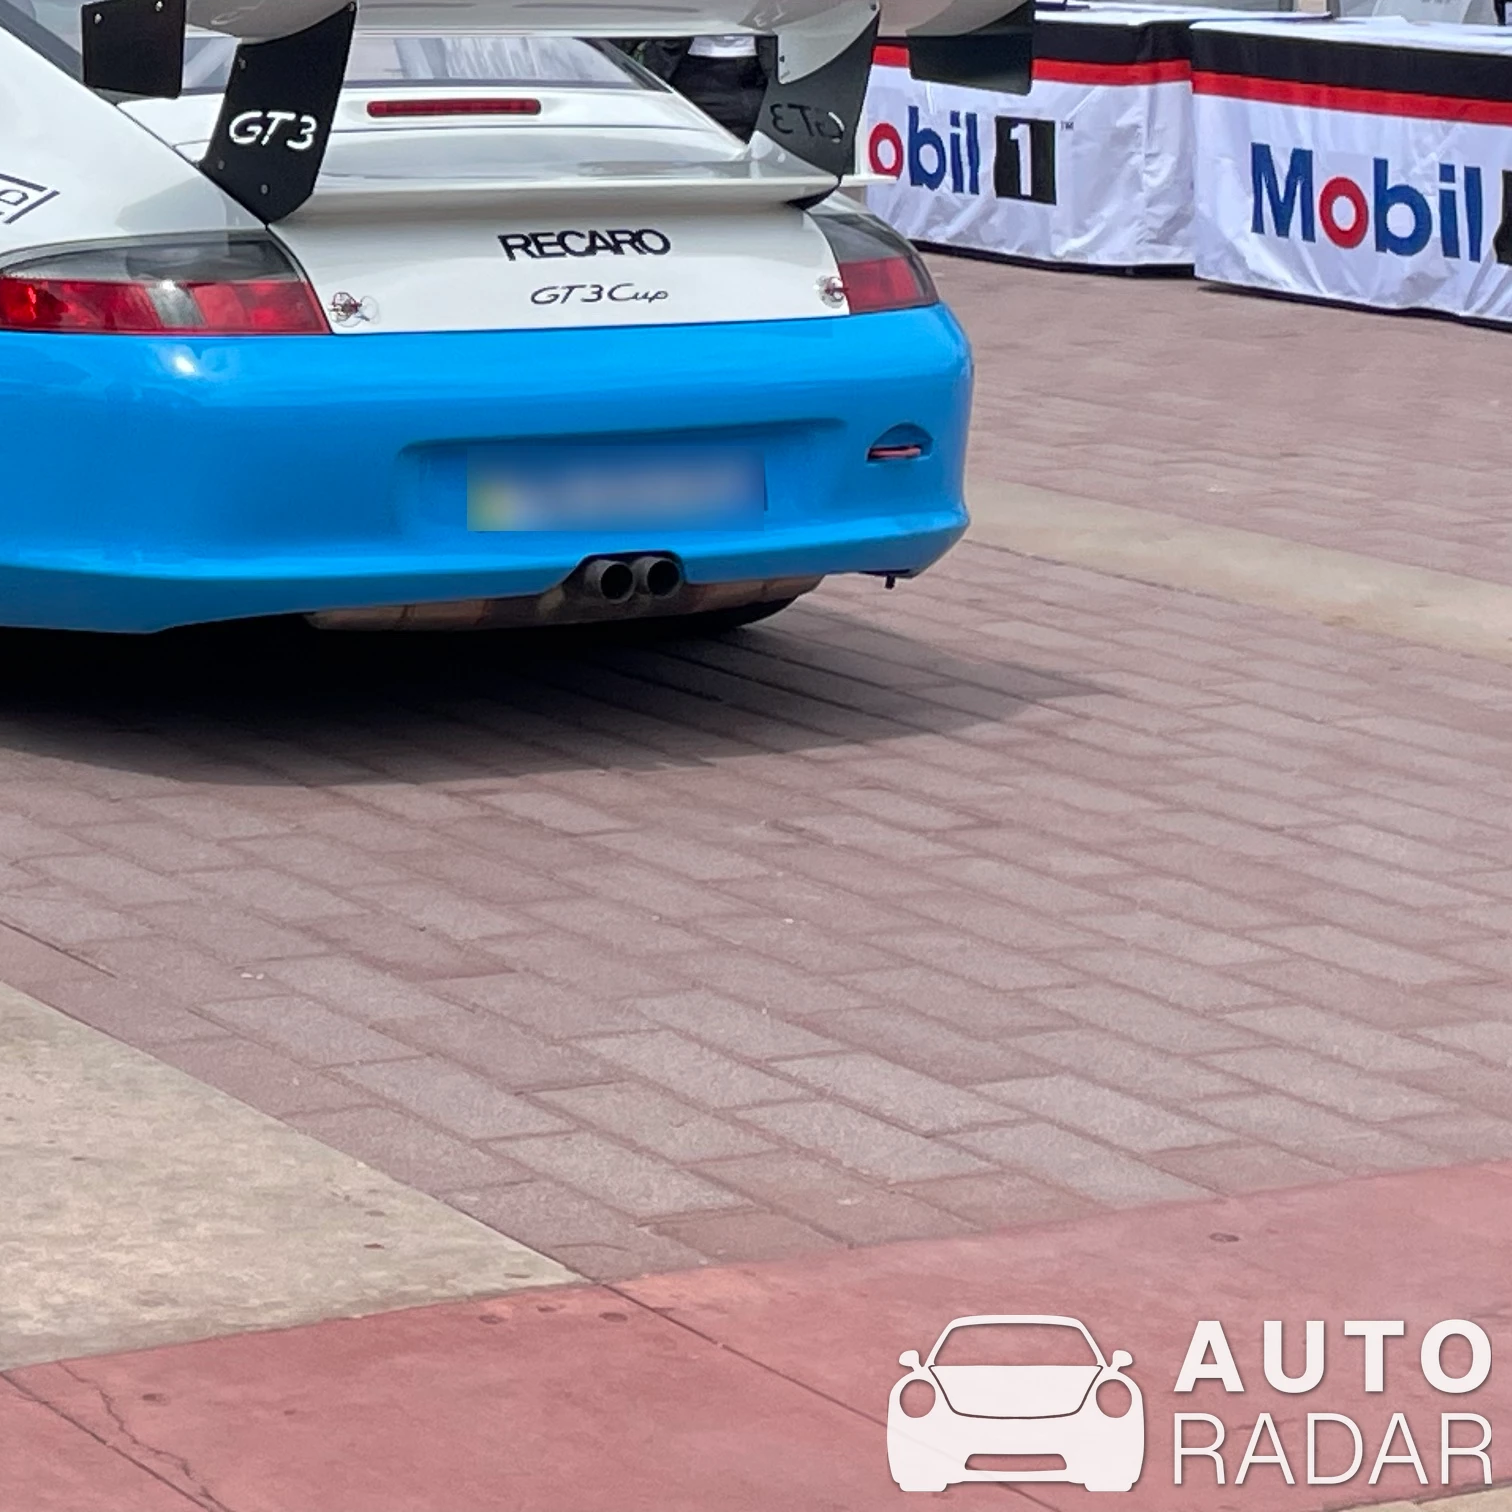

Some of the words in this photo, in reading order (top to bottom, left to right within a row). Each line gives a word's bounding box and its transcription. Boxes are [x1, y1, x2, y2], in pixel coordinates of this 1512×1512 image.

[228, 110, 318, 151] GT3
[868, 105, 981, 195] obil
[1010, 123, 1032, 197] 1
[1251, 141, 1483, 263] Mobil
[497, 228, 672, 261] RECARO
[530, 284, 604, 305] GT3
[607, 282, 670, 304] Cup
